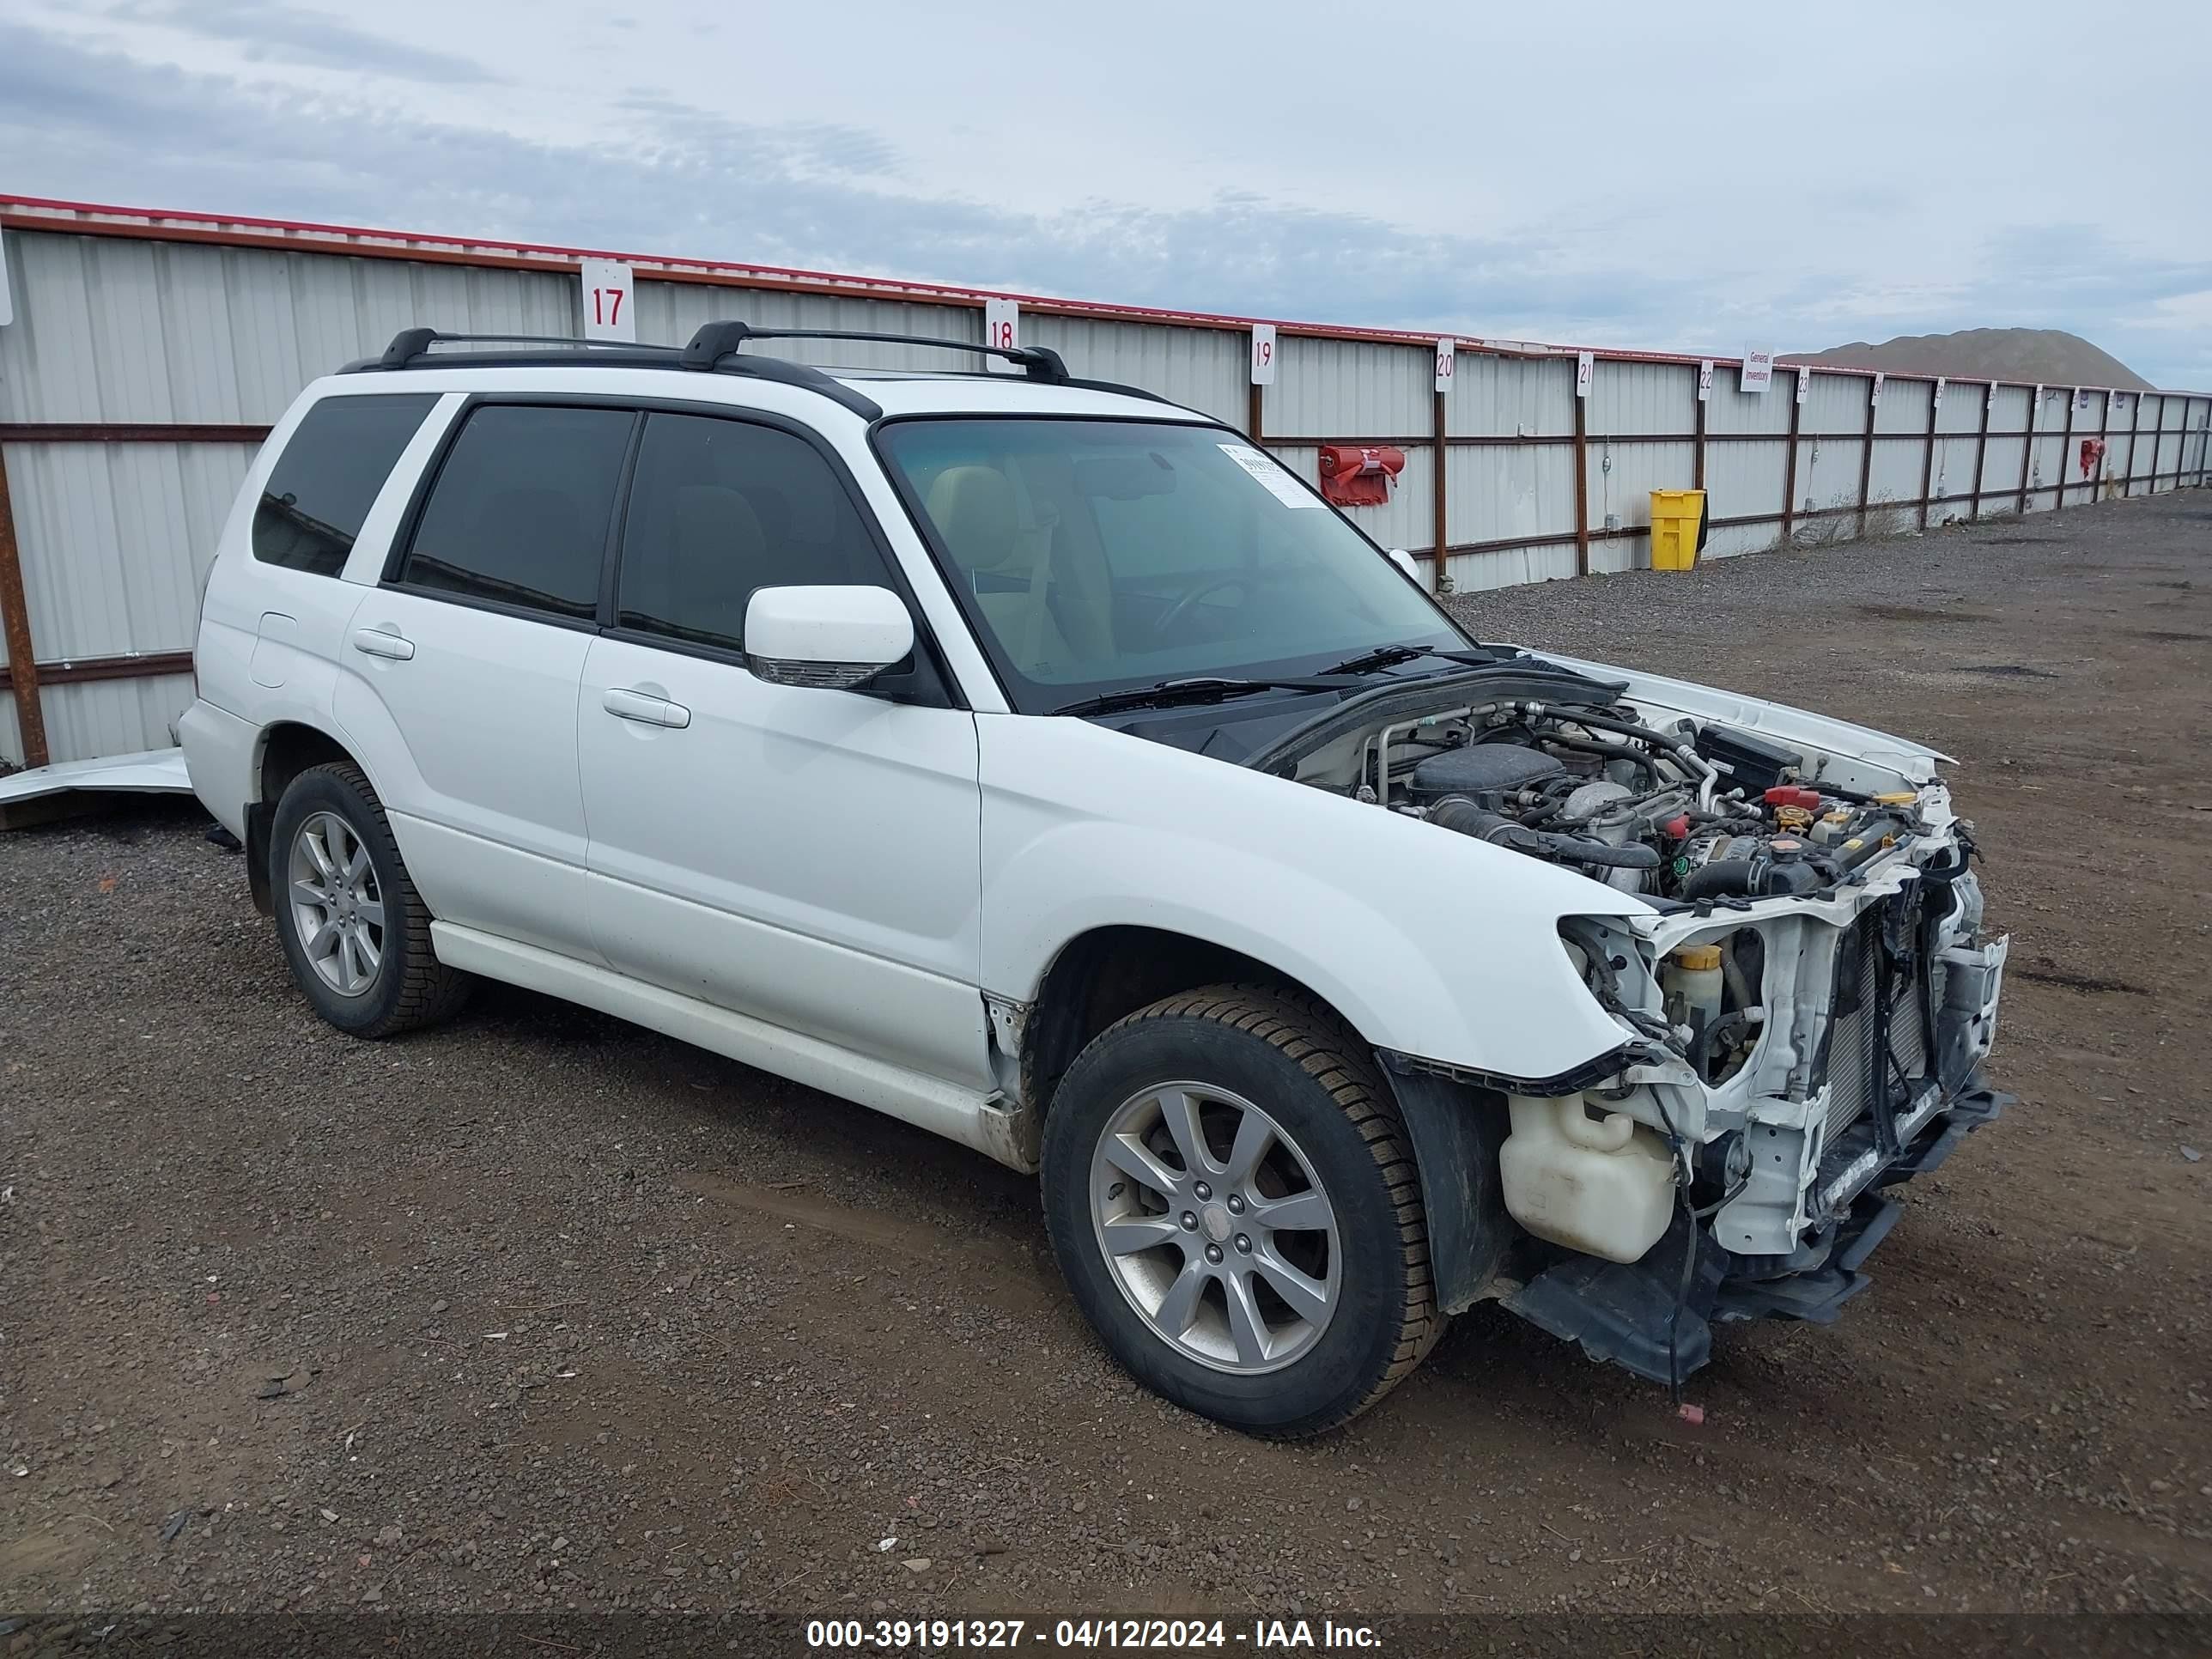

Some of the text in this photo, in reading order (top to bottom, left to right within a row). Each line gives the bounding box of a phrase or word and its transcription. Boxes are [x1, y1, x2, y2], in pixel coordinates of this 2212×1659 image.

[594, 289, 623, 325] 17
[993, 321, 1012, 349] 18
[1256, 342, 1271, 367] 19
[1750, 350, 1770, 364] General
[1437, 353, 1452, 377] 20
[1580, 363, 1591, 384] 21
[1700, 371, 1712, 389] 22
[1746, 369, 1769, 383] Inventory
[1798, 376, 1808, 392] 23
[1874, 380, 1882, 397] 24
